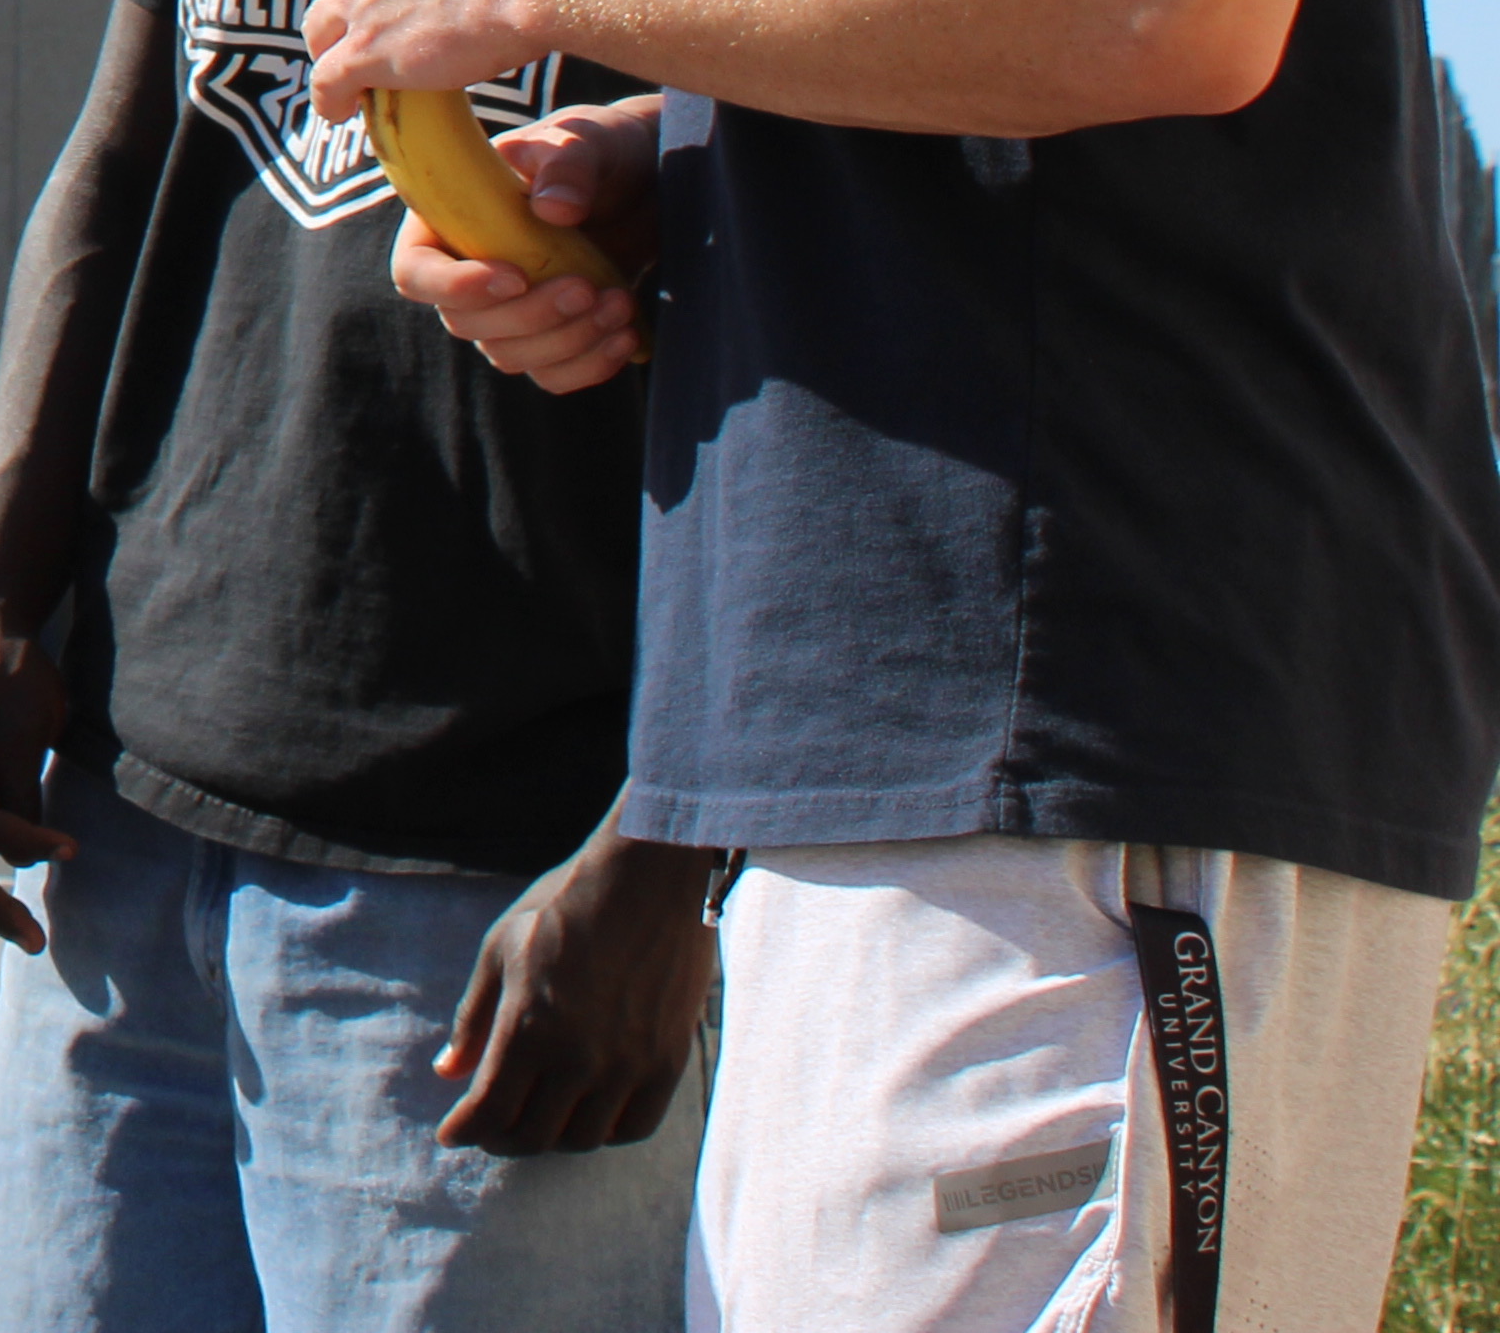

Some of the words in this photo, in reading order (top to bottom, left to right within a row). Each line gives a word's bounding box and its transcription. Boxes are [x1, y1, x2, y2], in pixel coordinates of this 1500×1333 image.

[1173, 931, 1218, 1076] GRAND
[1157, 993, 1194, 1194] UNIVERSITY
[1194, 1084, 1227, 1254] CANYON
[965, 1164, 1094, 1209] LEGENDS
